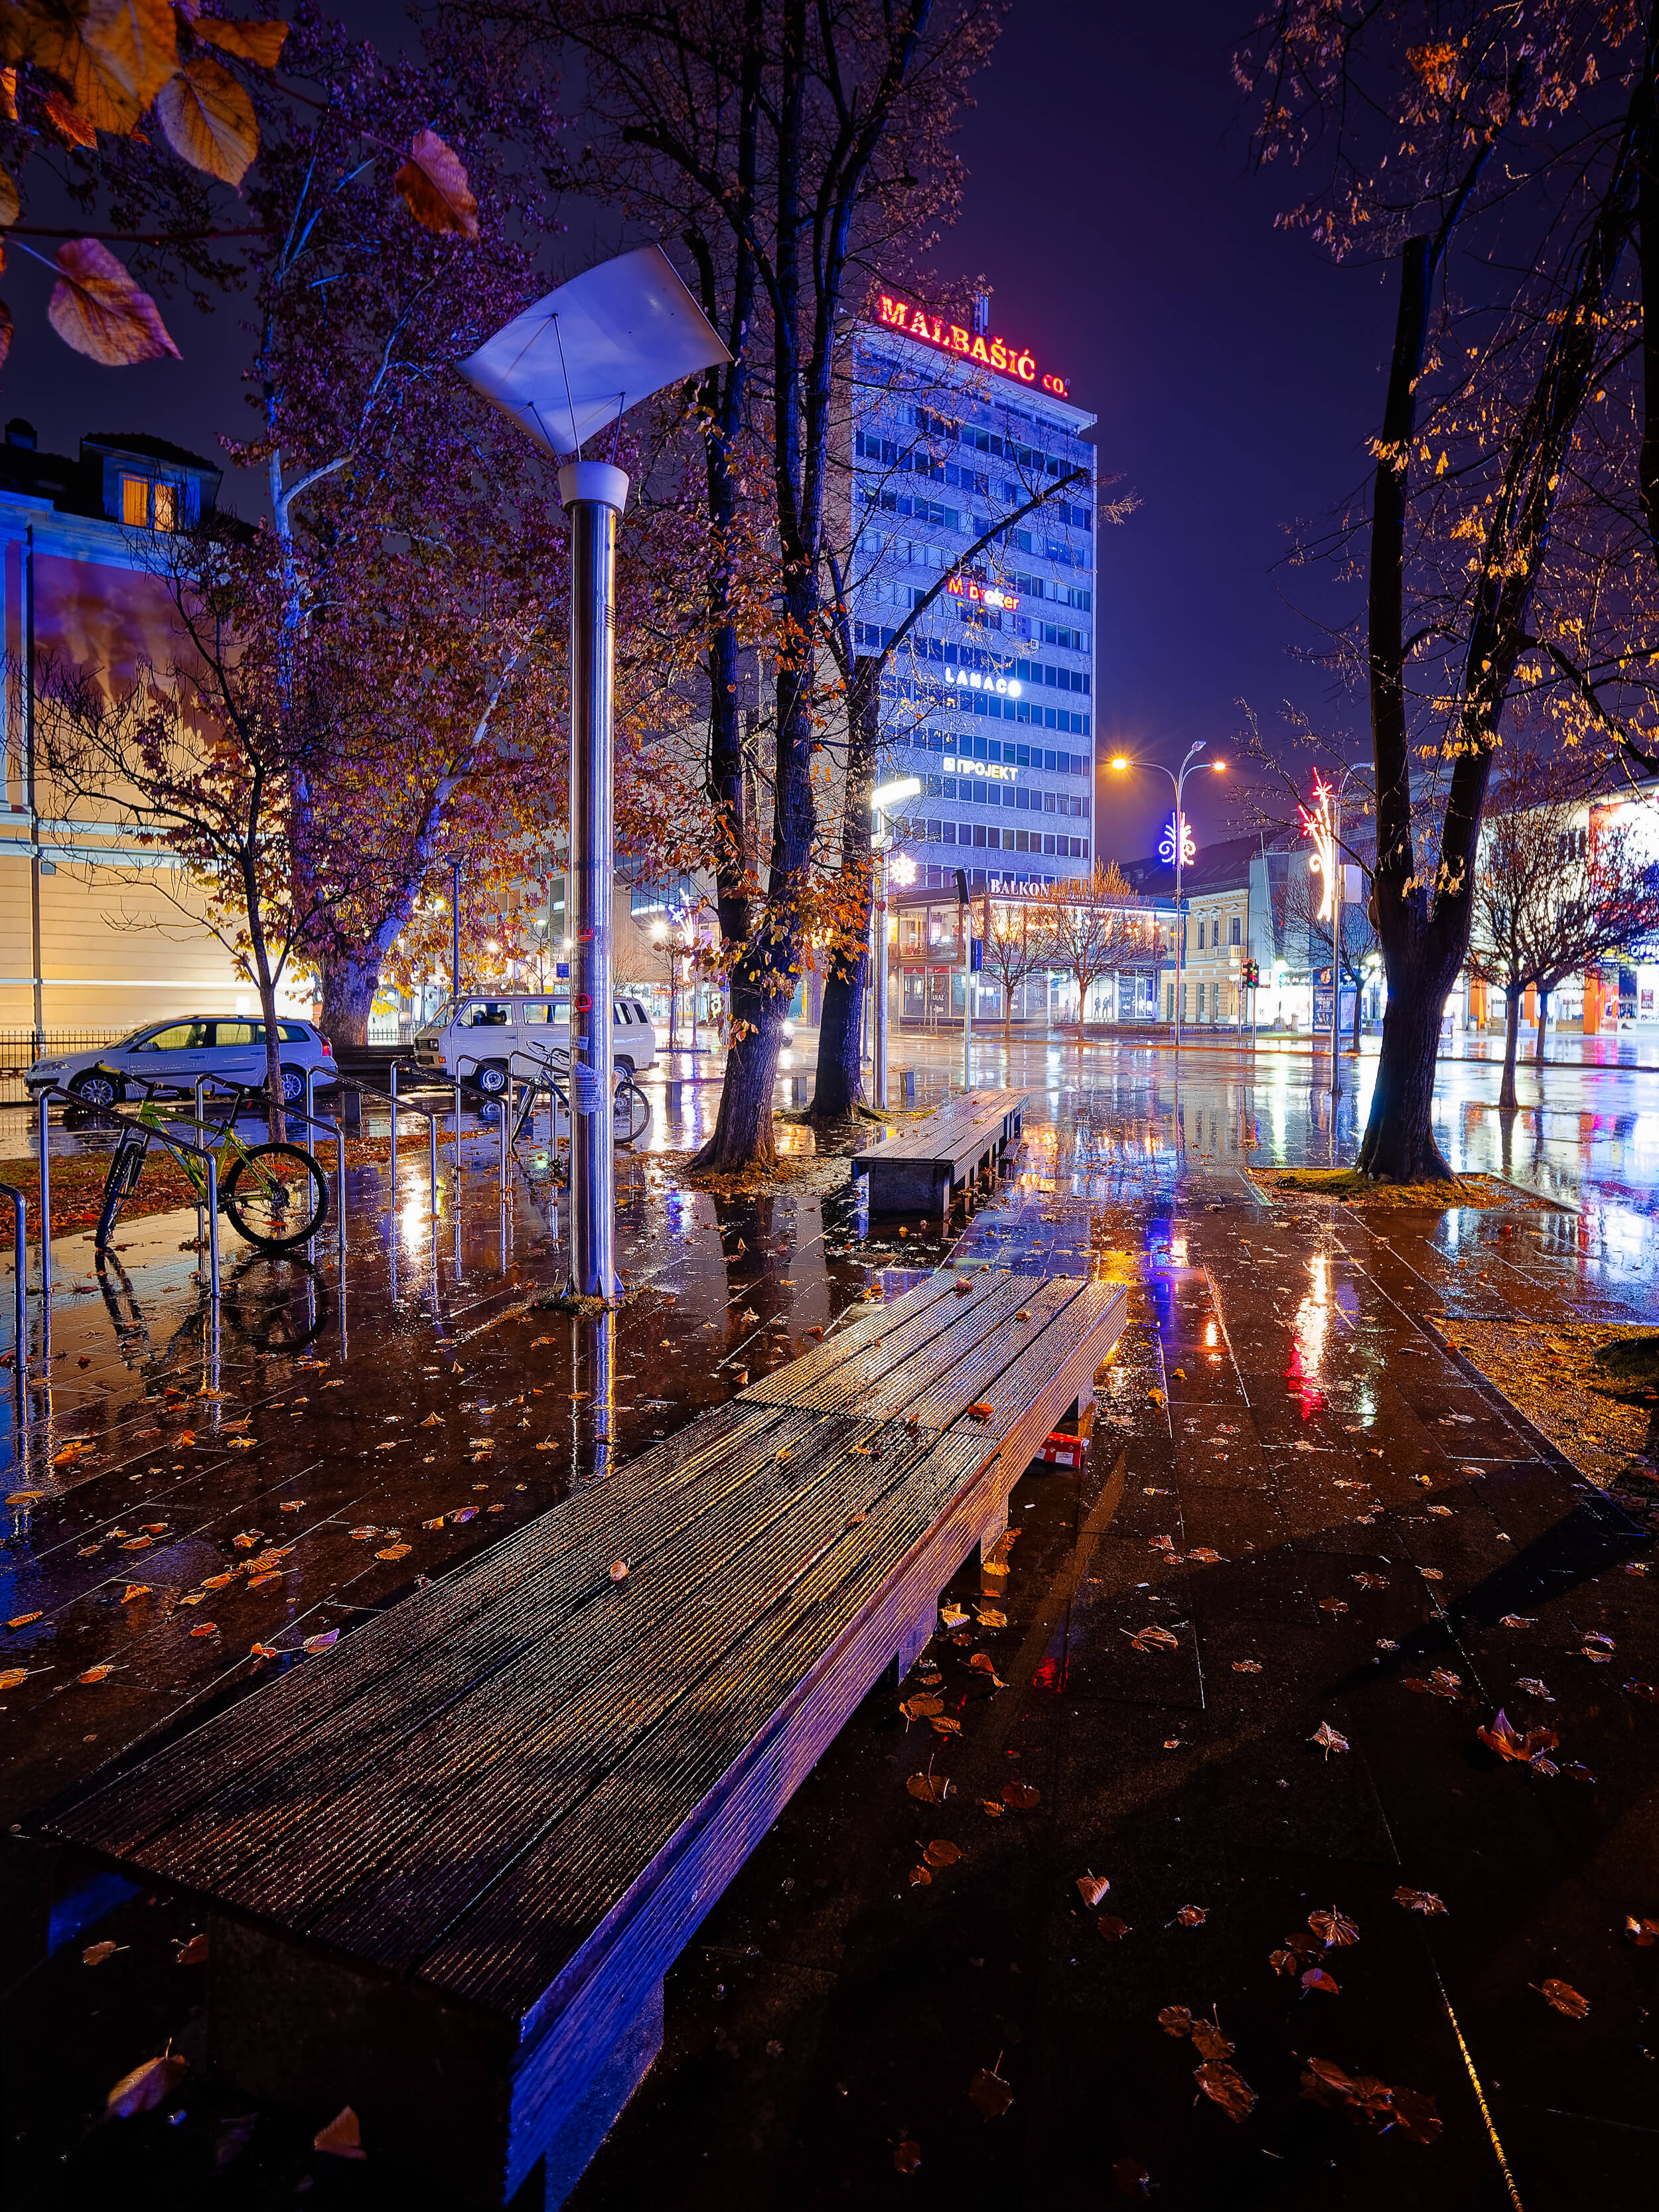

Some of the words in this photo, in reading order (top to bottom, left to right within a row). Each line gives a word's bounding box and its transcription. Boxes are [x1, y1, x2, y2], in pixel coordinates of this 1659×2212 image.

[879, 295, 1036, 382] MALBAŠIĆ
[945, 667, 1022, 698] LANACO
[990, 878, 1050, 898] BALKON
